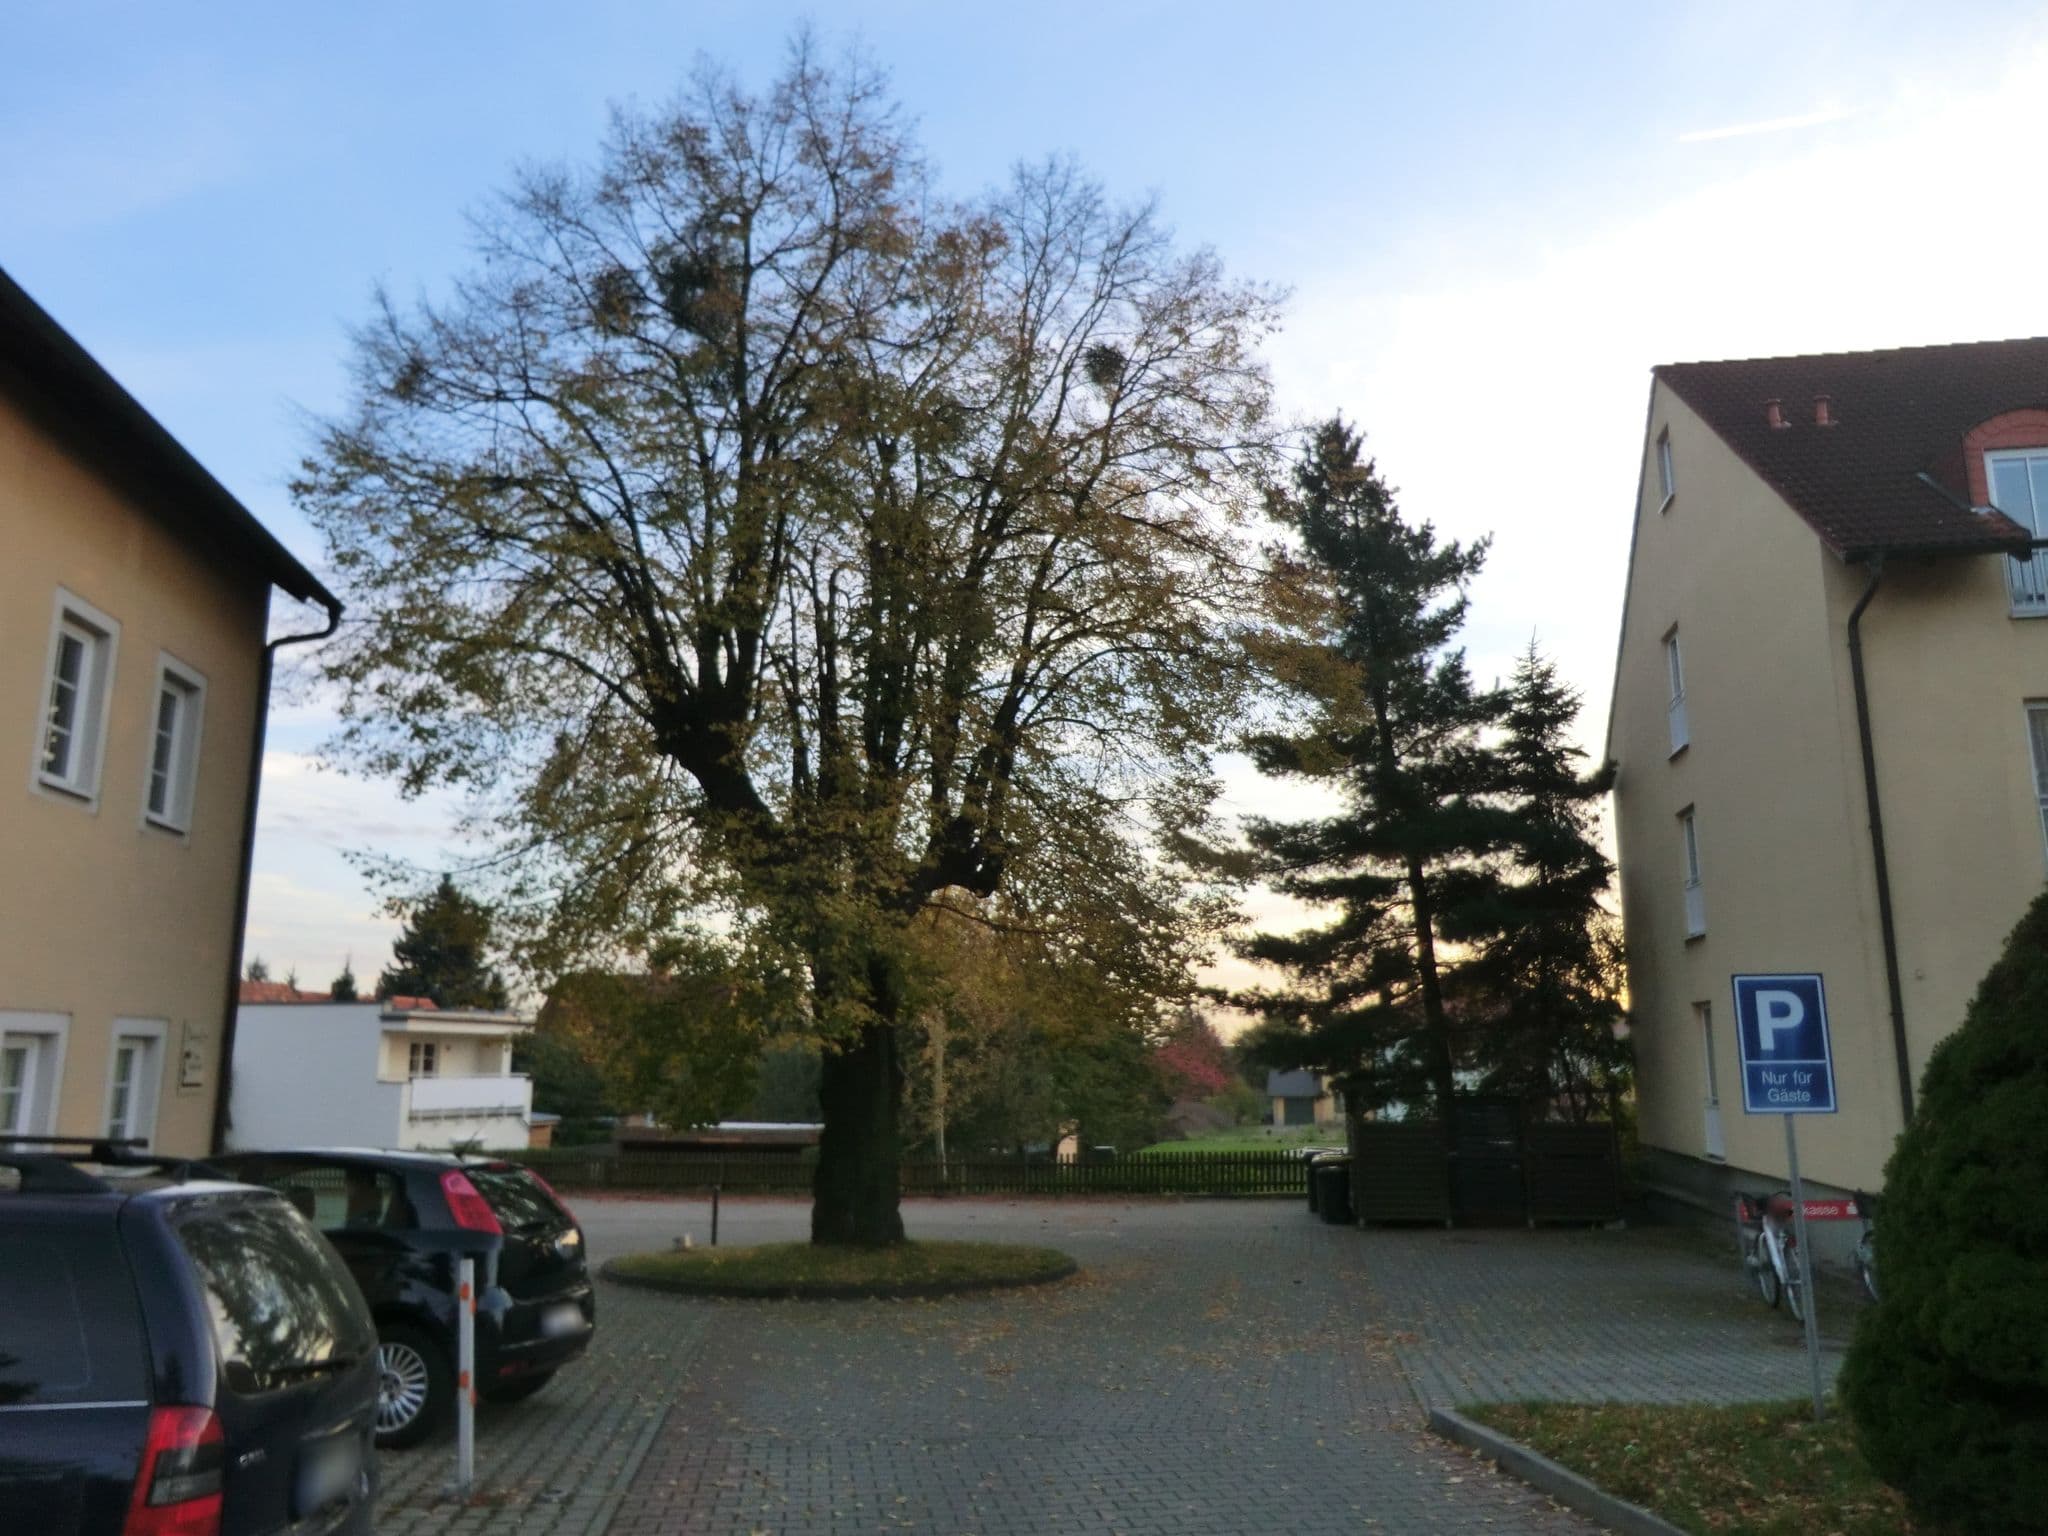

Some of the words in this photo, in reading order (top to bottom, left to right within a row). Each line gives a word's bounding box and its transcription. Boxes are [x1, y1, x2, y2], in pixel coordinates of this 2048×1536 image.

[1756, 990, 1804, 1050] P
[1761, 1071, 1788, 1085] Nur
[1793, 1070, 1813, 1085] für
[1767, 1088, 1811, 1103] Gäste
